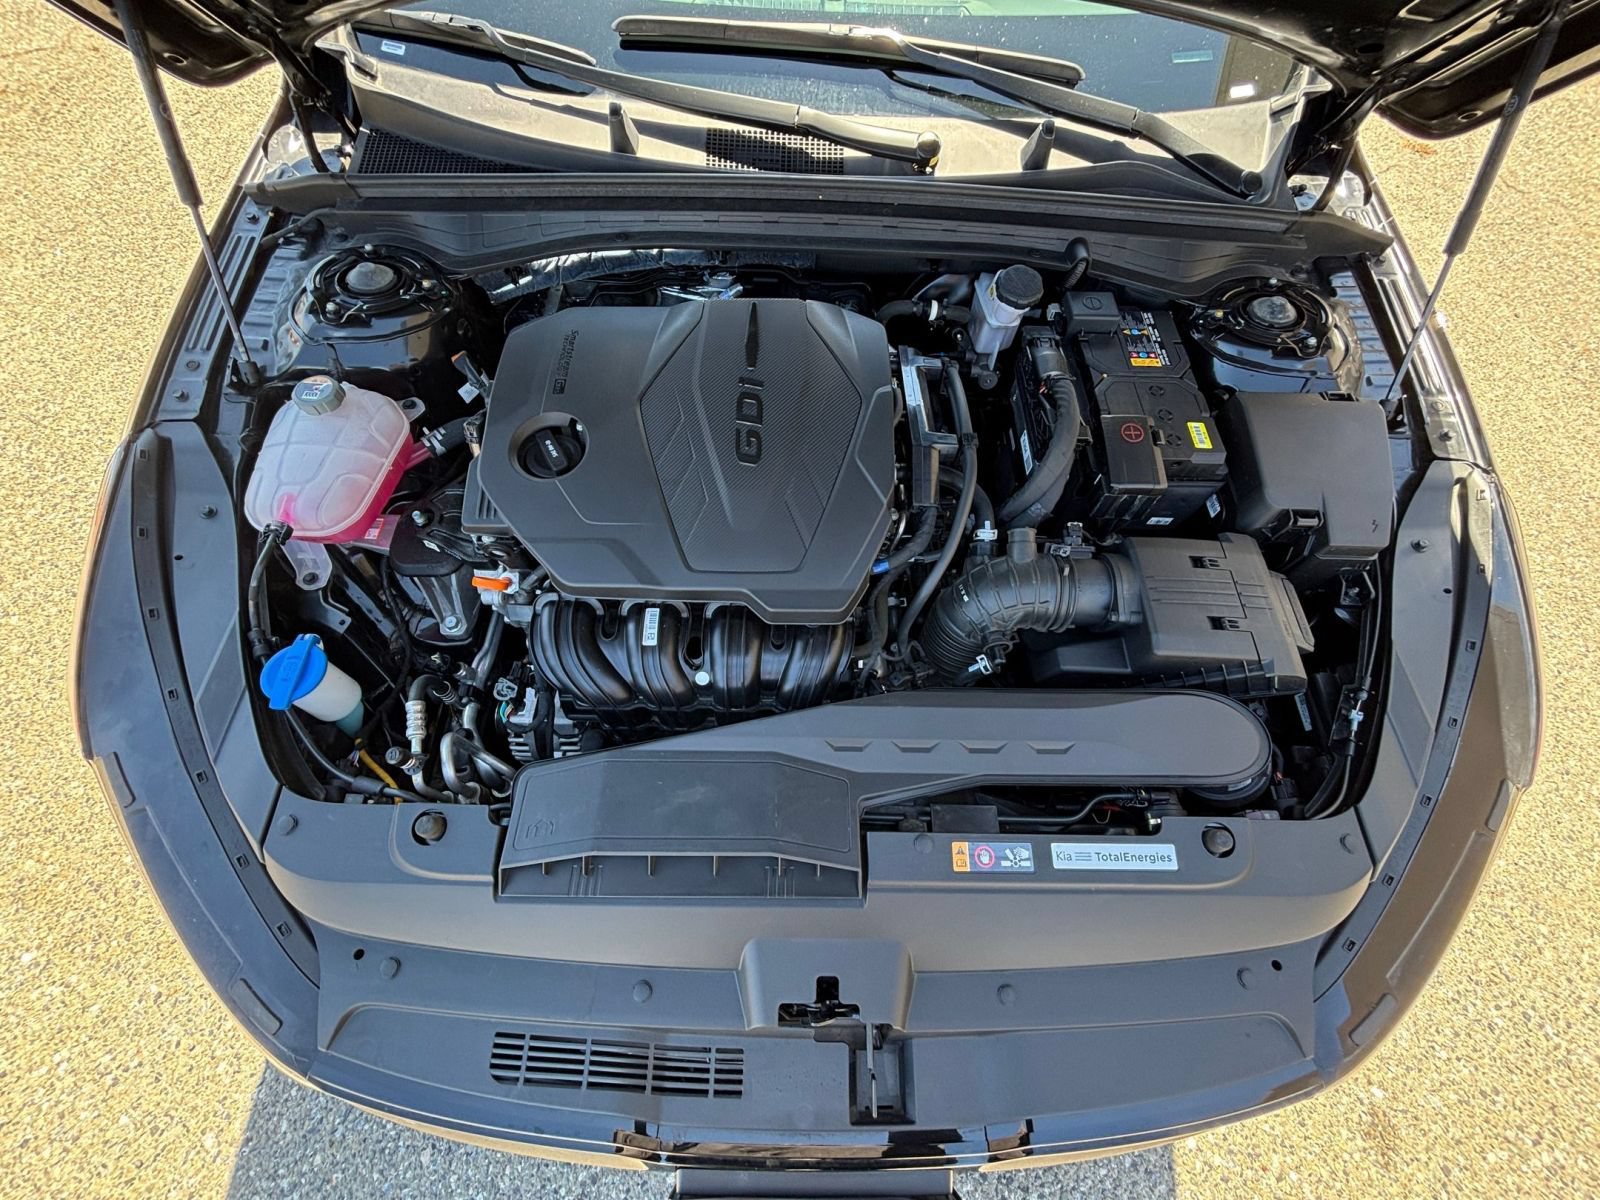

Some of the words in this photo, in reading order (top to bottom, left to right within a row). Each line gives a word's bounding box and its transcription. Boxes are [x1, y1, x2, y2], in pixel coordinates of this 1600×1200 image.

[561, 329, 580, 378] Smartstream
[1055, 850, 1073, 862] Kia
[1094, 851, 1173, 864] TotalEnergies
